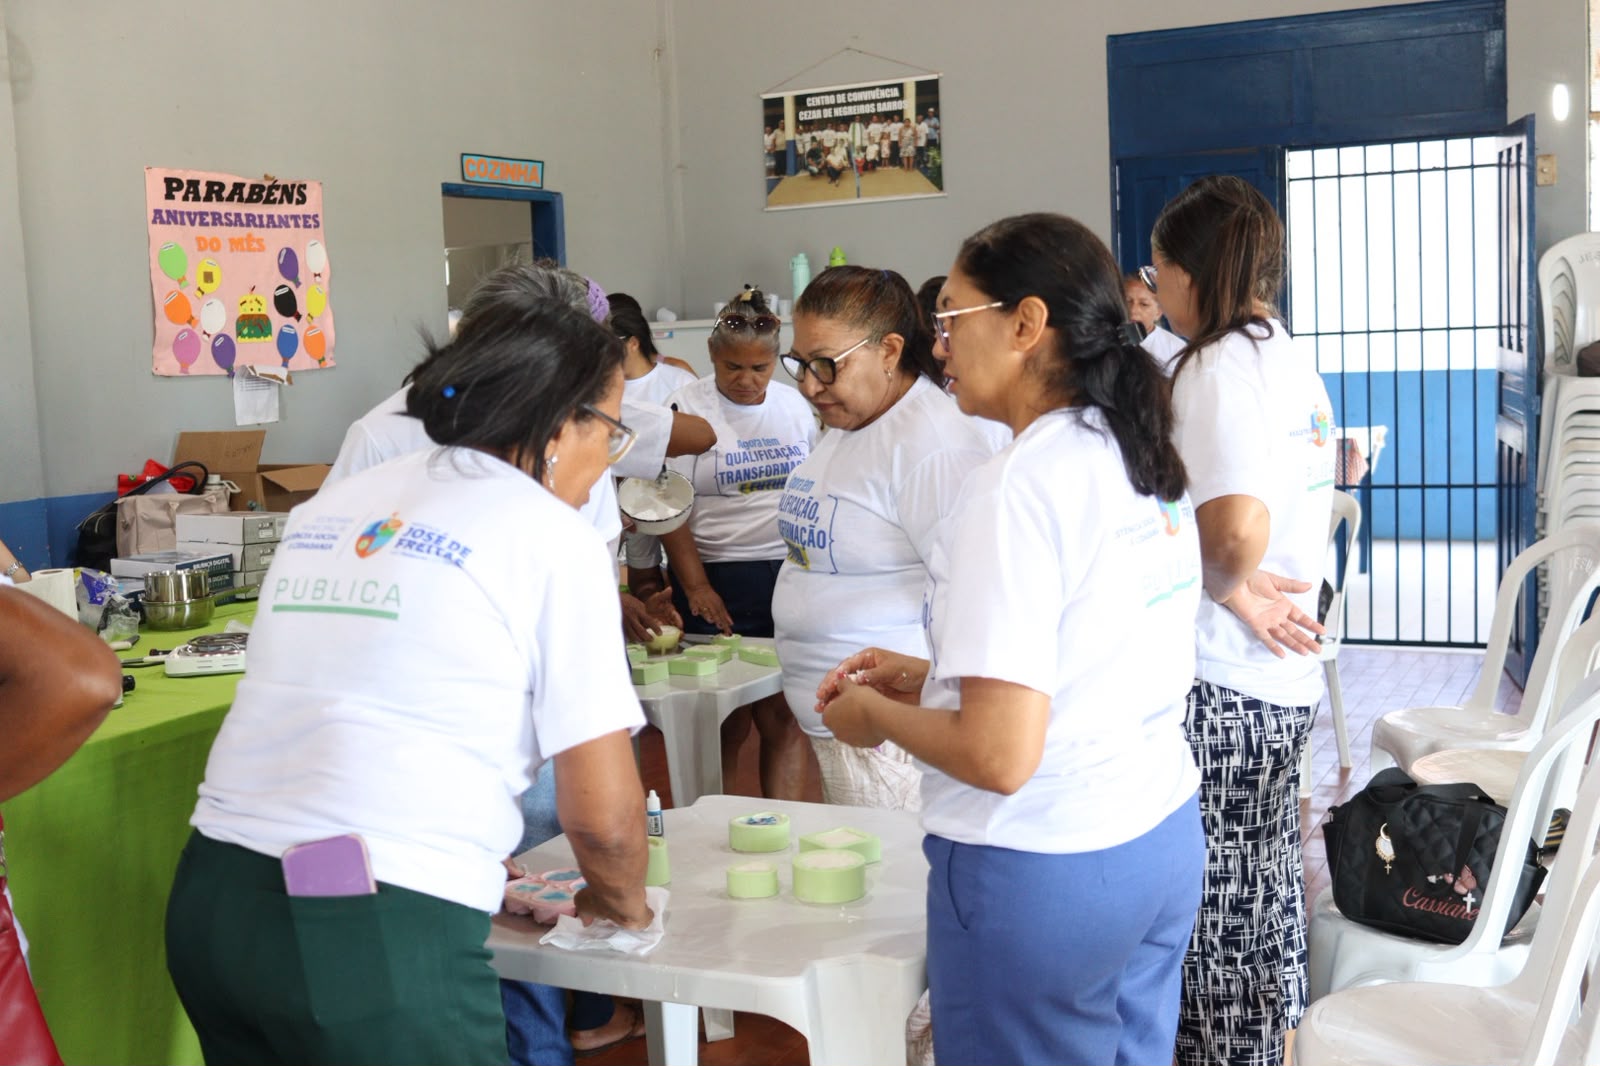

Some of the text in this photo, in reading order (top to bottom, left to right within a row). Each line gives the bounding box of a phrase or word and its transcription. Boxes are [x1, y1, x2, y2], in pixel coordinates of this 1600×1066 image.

[806, 87, 900, 107] CENTRO DE CONVIVÊNCIA
[798, 100, 908, 121] CEZAR DE NEGREIROS BARROS
[464, 158, 539, 184] COZINHA
[163, 177, 307, 205] PARABÉNS
[151, 209, 320, 229] ANIVERSARIANTES
[195, 232, 266, 253] DO MÊS
[725, 445, 805, 466] QUALIFICAÇÃO,
[402, 526, 448, 545] JOSÉ
[448, 540, 472, 559] DE
